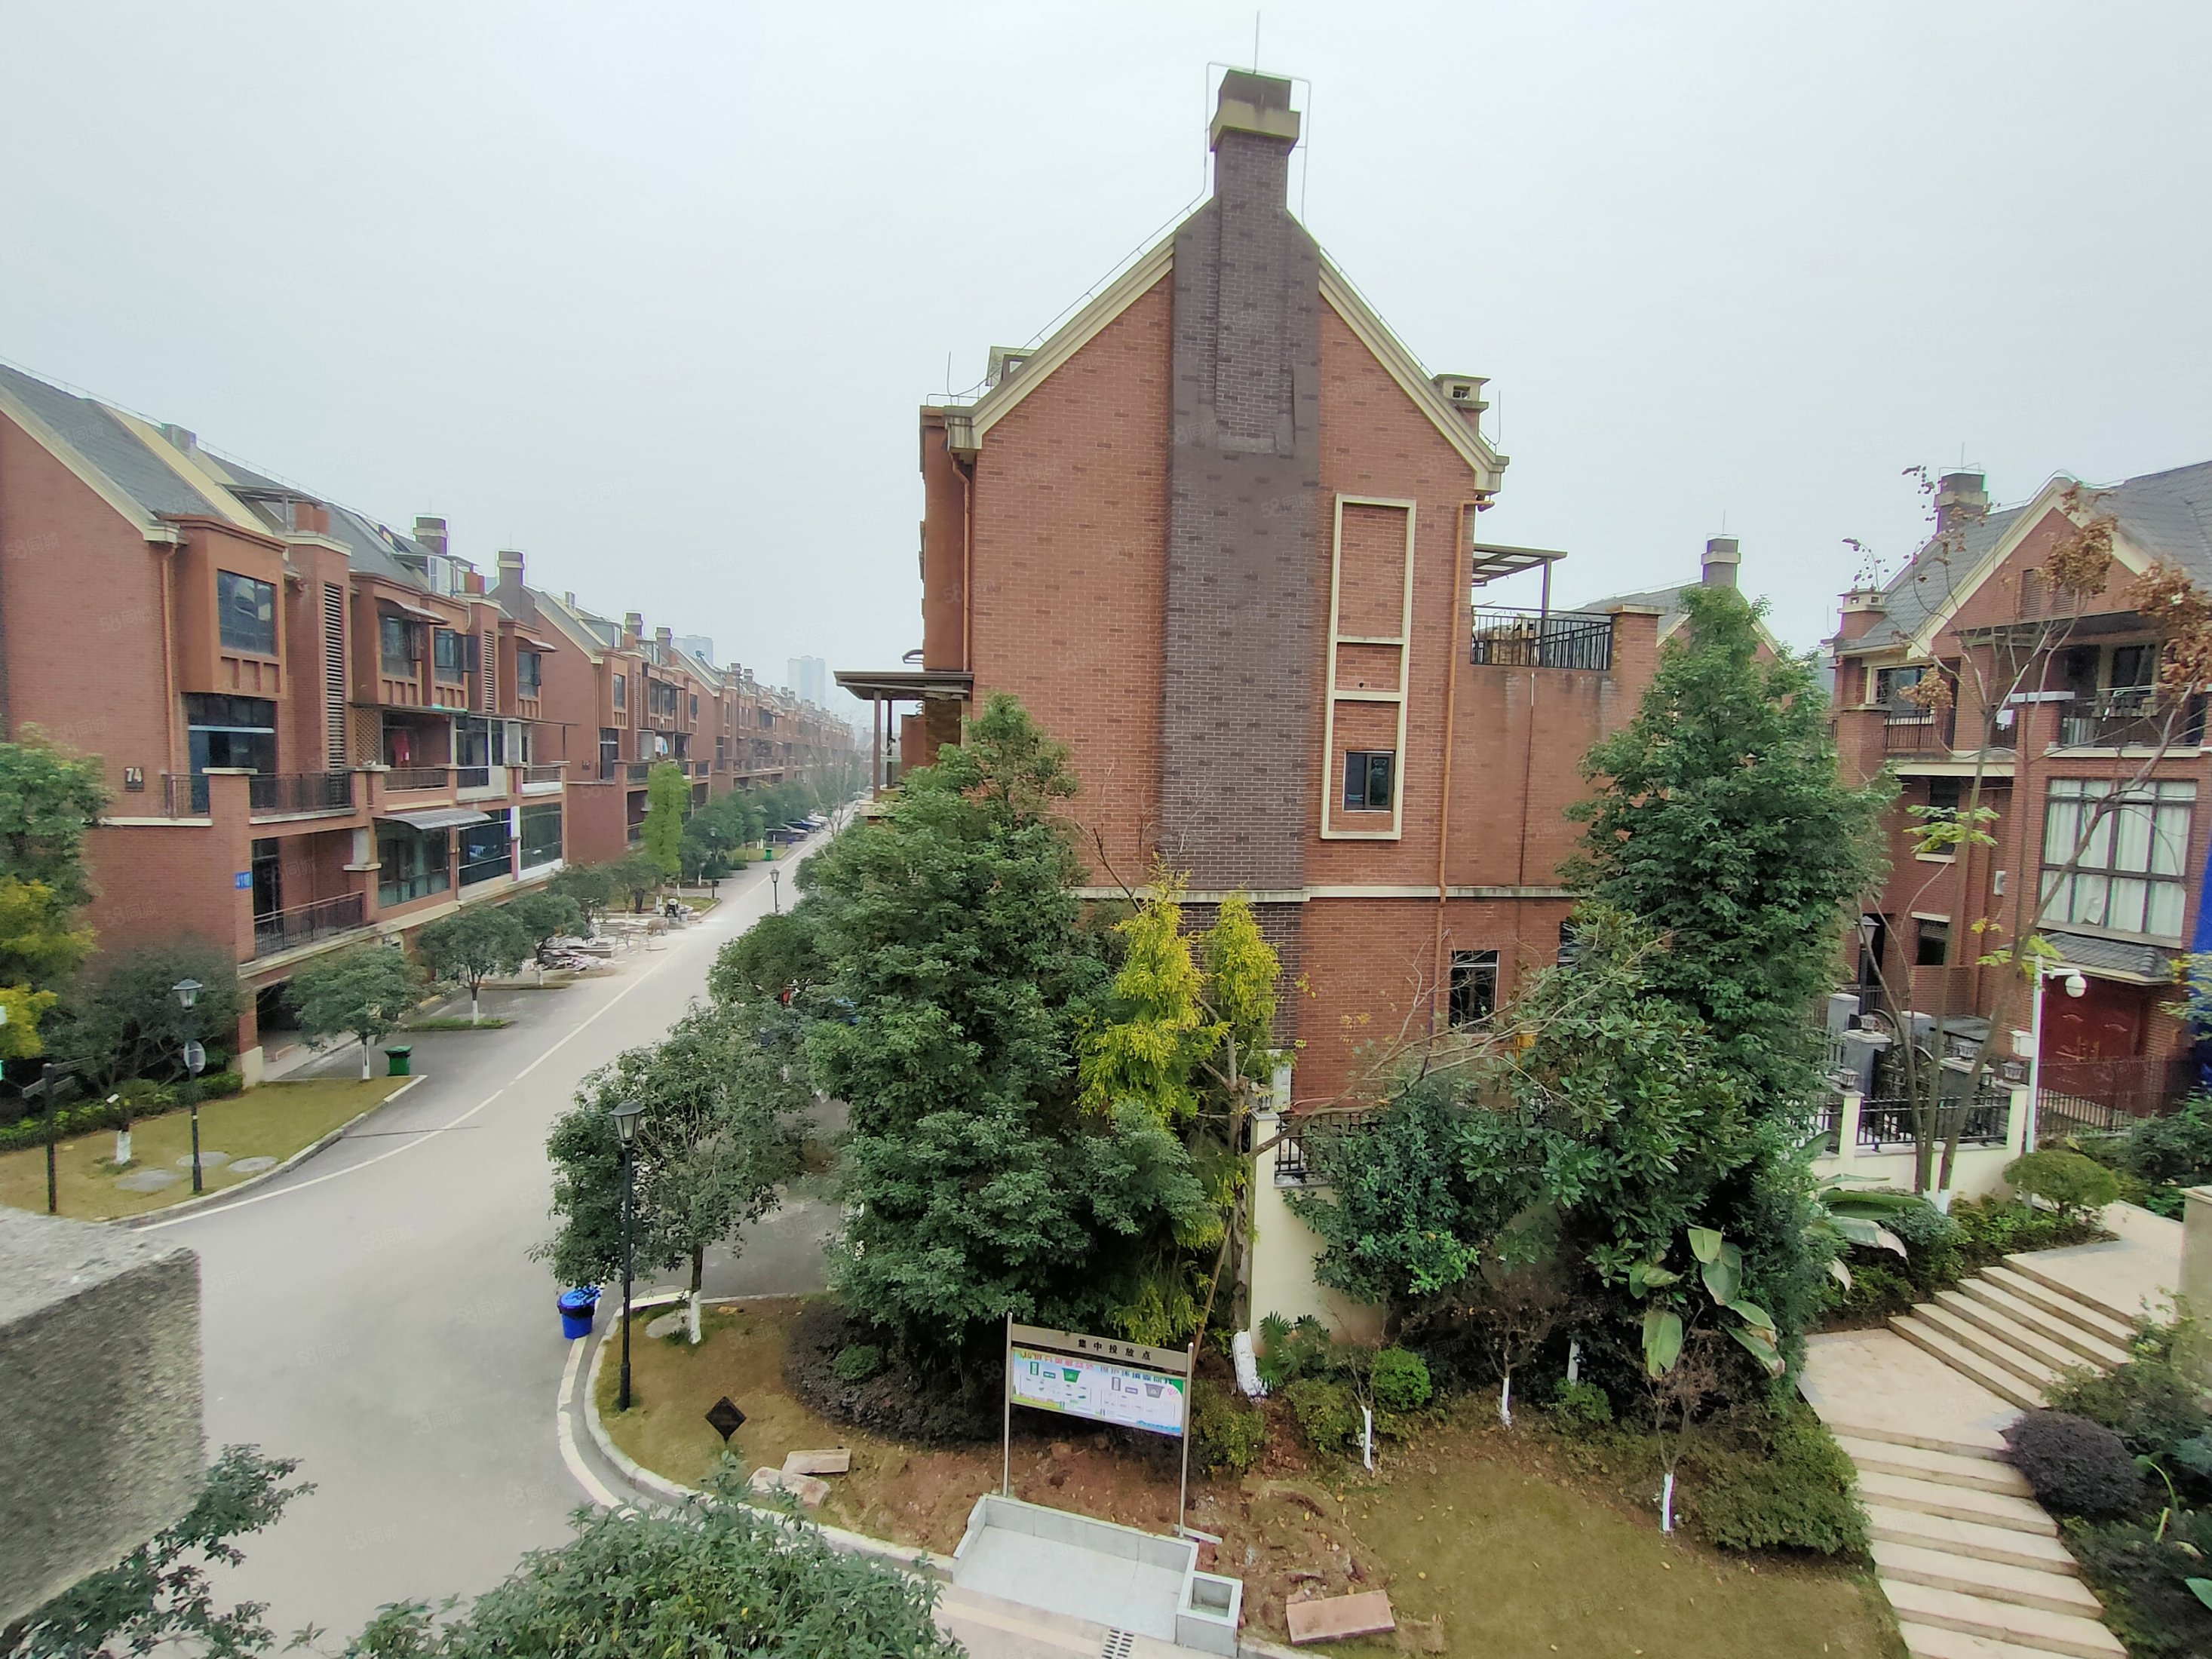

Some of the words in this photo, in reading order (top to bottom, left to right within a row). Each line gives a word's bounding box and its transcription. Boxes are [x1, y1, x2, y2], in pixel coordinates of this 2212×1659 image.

[125, 768, 142, 782] 74
[1078, 1339, 1152, 1360] 集中投放点
